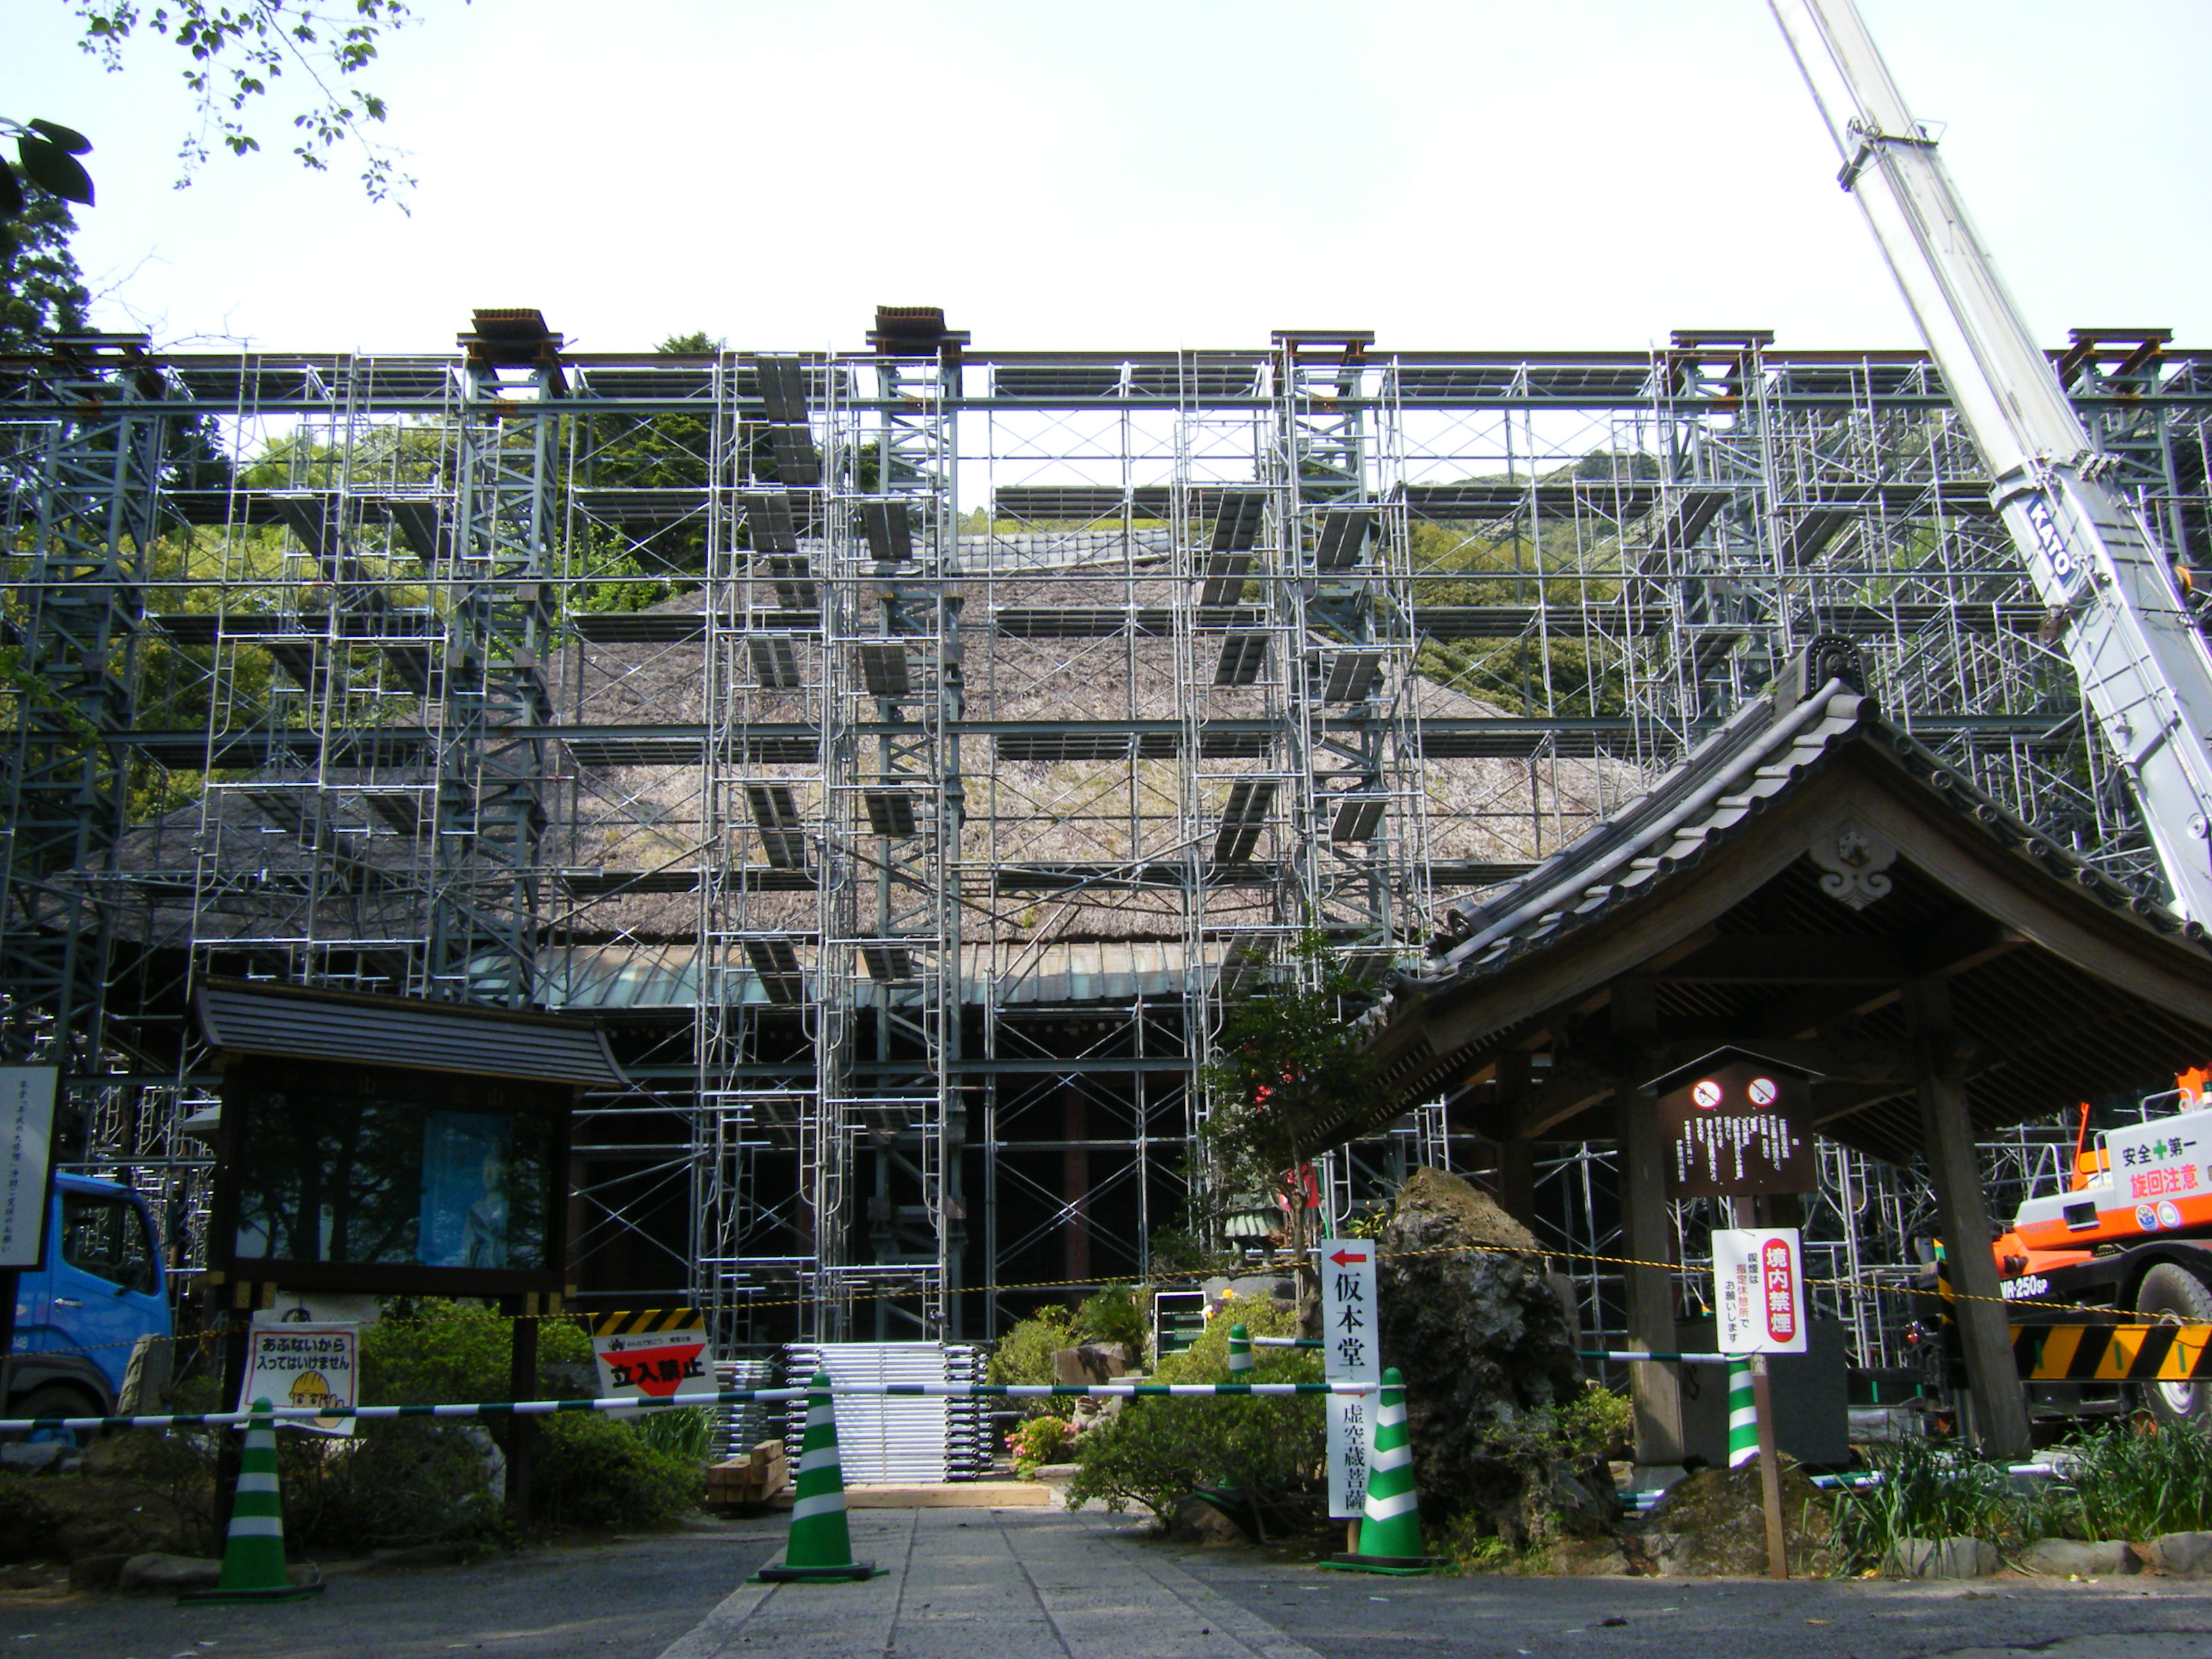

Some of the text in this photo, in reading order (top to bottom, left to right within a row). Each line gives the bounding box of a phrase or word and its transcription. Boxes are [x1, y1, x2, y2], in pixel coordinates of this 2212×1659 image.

[2029, 501, 2071, 576] KATO
[2123, 1136, 2196, 1167] 安全 第一
[2130, 1164, 2199, 1199] 旋回注意
[1747, 1252, 1759, 1284] 喫煙は
[1766, 1248, 1793, 1334] 境内禁煙
[1334, 1272, 1365, 1368] 仮本堂
[1725, 1280, 1738, 1343] お願いします
[262, 1336, 346, 1353] あぶないから
[256, 1354, 350, 1371] 入ってはいけません
[611, 1357, 706, 1389] 立入禁止
[1343, 1404, 1366, 1512] 虚空蔵菩薩
